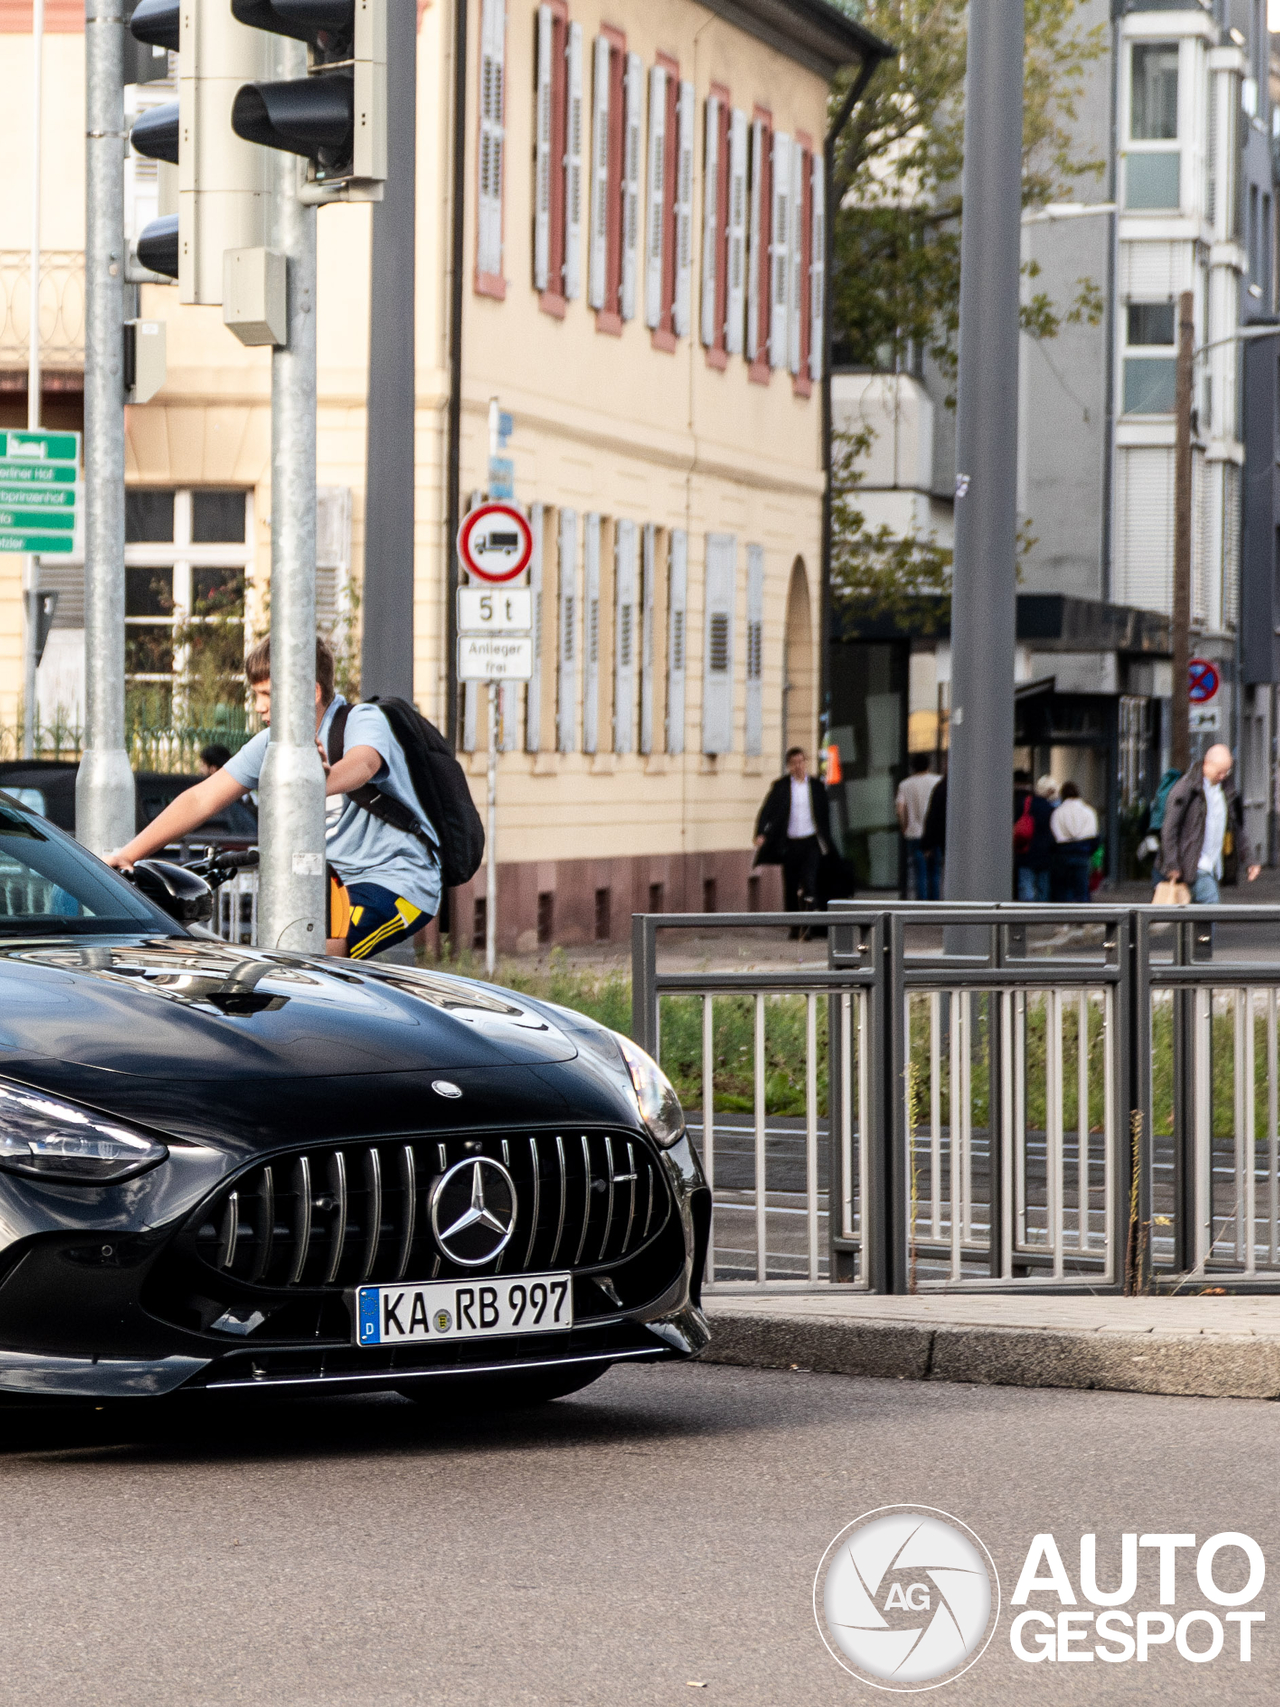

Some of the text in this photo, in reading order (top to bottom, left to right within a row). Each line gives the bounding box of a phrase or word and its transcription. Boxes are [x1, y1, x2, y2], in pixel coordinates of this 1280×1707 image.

[34, 467, 54, 480] Hof
[480, 596, 512, 621] 5 t
[468, 642, 522, 656] Anlieger
[486, 661, 507, 673] frei
[365, 1281, 568, 1336] D KA RB 997
